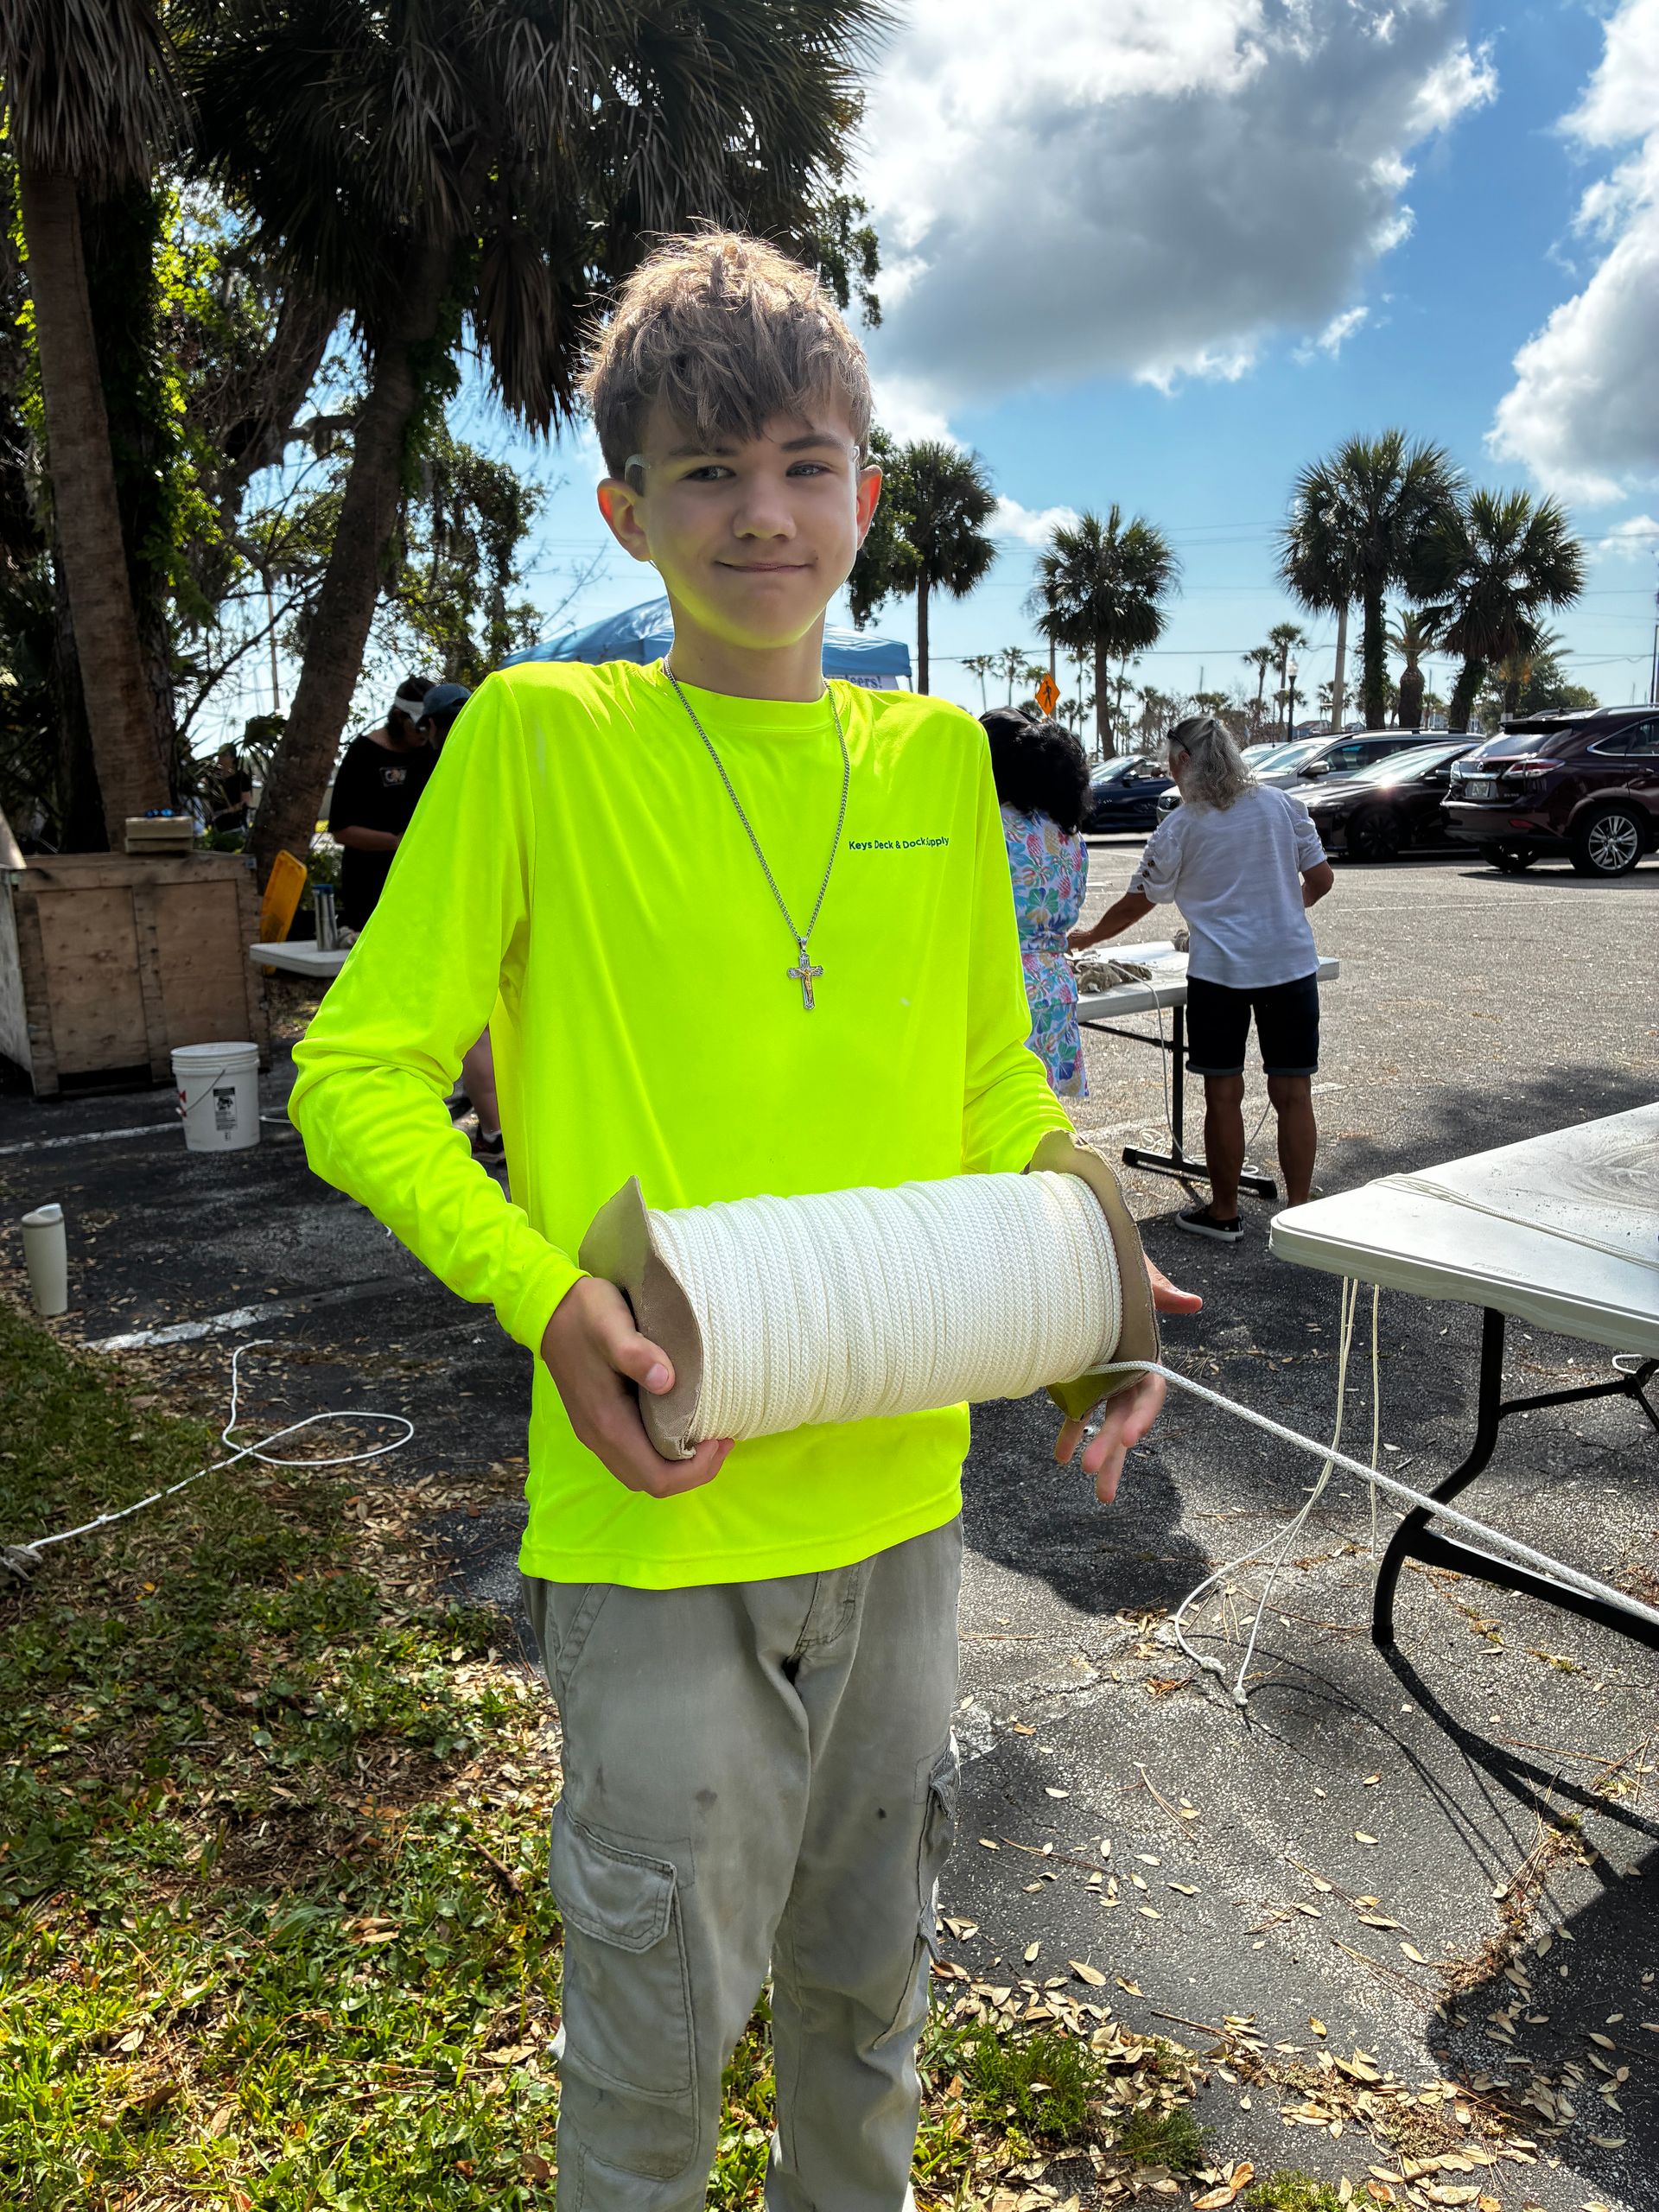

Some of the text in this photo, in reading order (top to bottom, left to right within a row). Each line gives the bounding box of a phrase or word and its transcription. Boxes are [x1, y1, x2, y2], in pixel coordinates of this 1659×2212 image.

[849, 841, 872, 850] Keys
[874, 840, 893, 849] Deck
[895, 840, 900, 849] &
